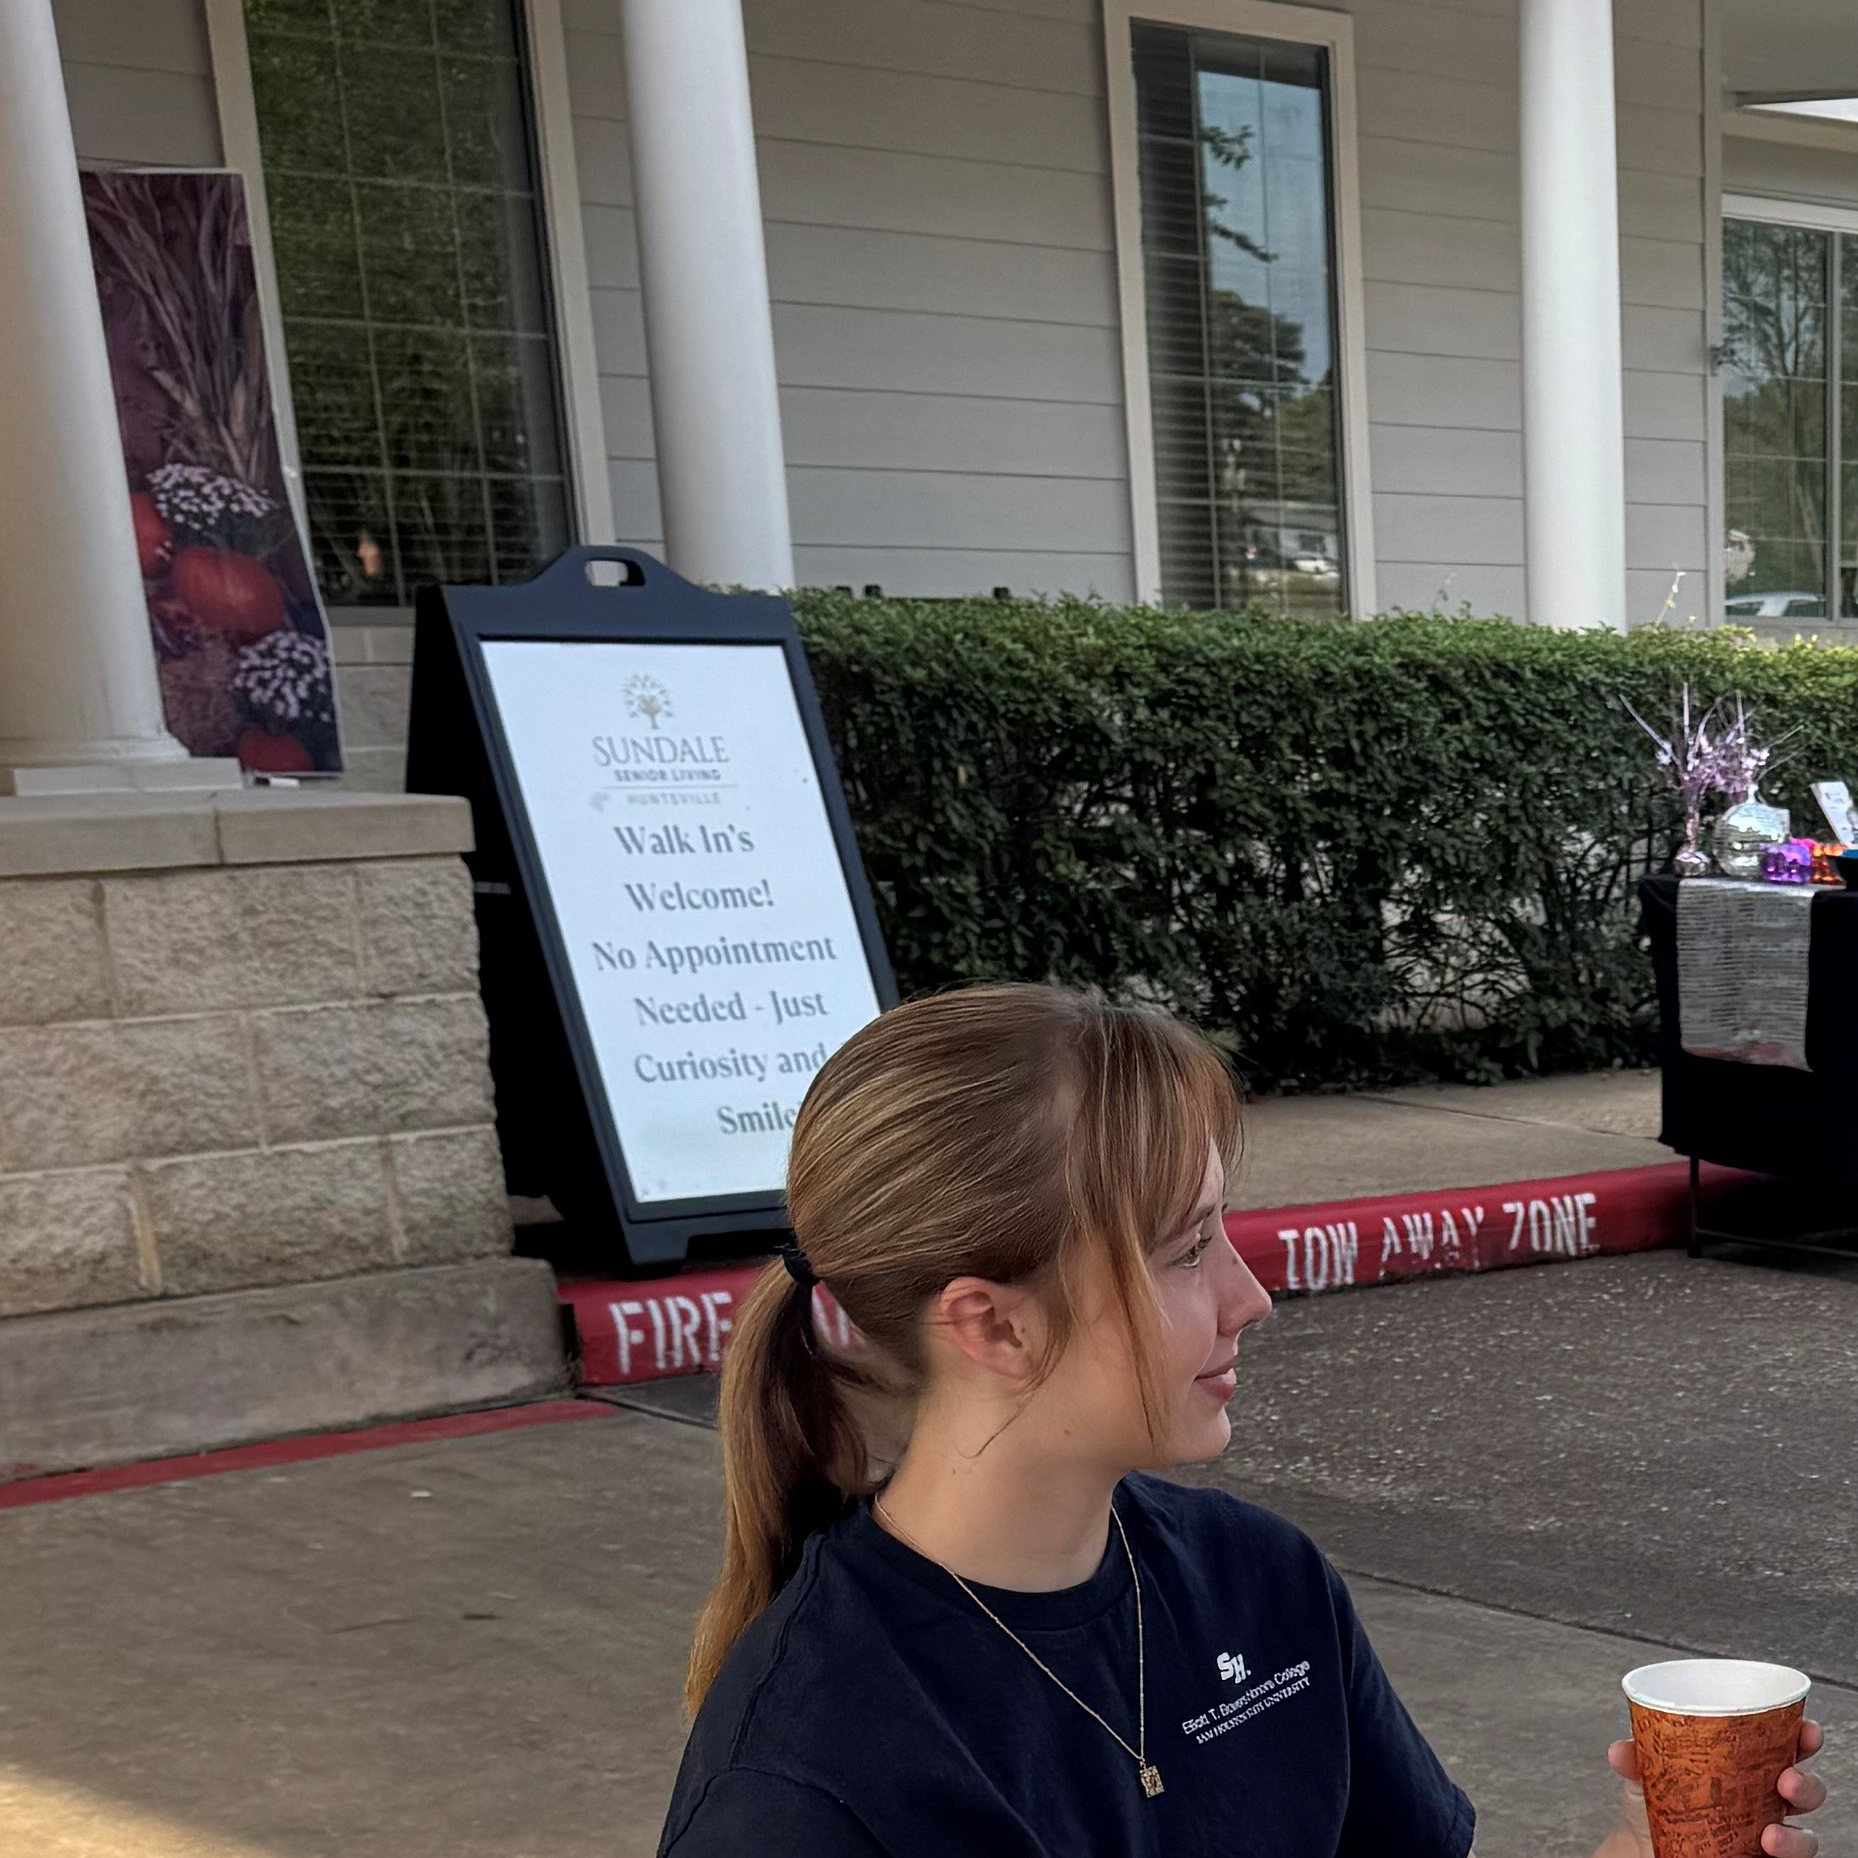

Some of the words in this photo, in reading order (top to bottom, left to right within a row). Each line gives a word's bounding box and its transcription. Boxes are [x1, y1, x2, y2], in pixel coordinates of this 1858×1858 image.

[592, 736, 730, 767] SUNDALE
[614, 769, 668, 782] SENIOR
[671, 769, 721, 782] LIVING
[626, 792, 721, 806] HUNTSVILLE
[614, 824, 696, 855] Walk
[699, 823, 755, 854] In's
[624, 879, 775, 912] Welcome!
[591, 941, 637, 972] No
[645, 936, 838, 975] Appointment
[634, 991, 748, 1027] Needed
[770, 990, 830, 1026] Just
[634, 1047, 768, 1084] Curiosity
[778, 1042, 829, 1075] and
[1277, 1221, 1359, 1291] TOW
[1379, 1205, 1485, 1279] AWAY
[1502, 1192, 1601, 1257] ZONE
[608, 1291, 733, 1375] FIRE
